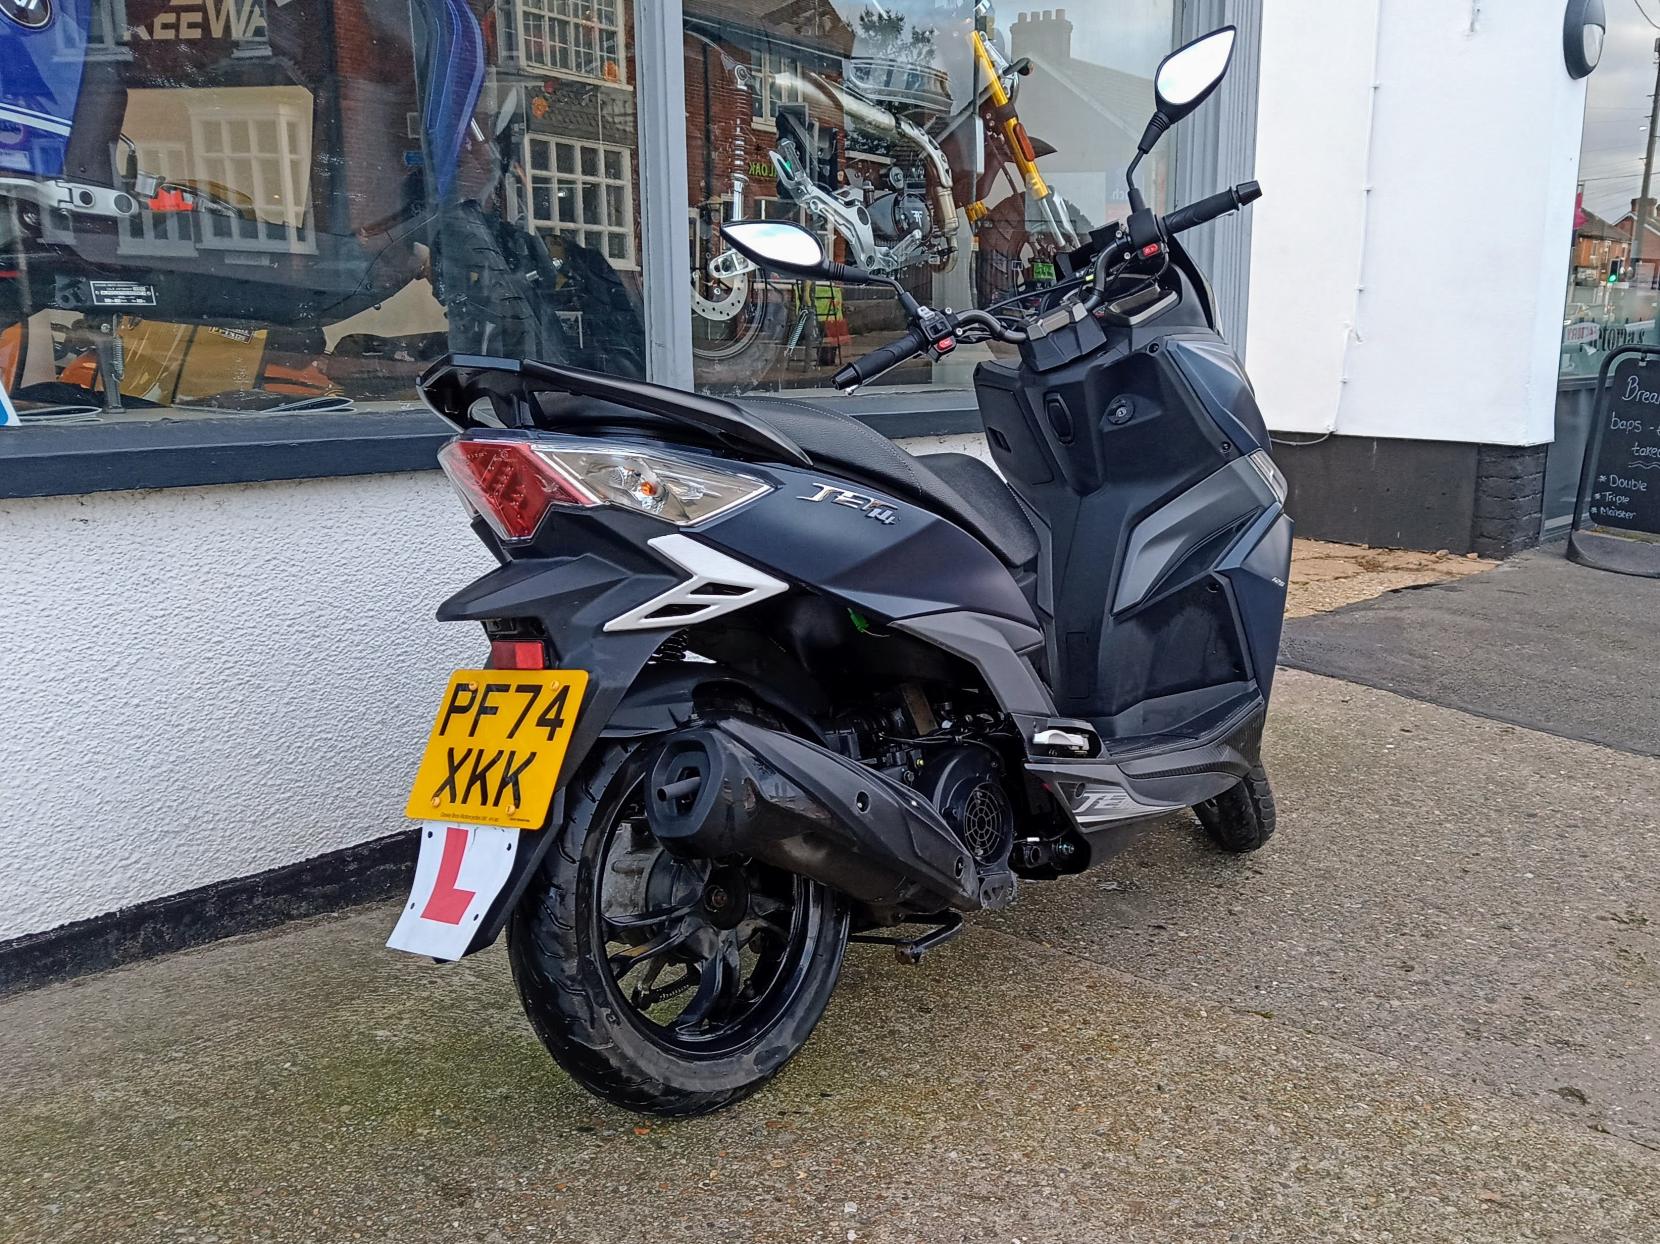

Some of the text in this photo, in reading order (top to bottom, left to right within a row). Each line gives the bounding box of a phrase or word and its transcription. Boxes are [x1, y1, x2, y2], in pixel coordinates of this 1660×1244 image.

[1611, 411, 1642, 434] baps
[1601, 491, 1630, 506] Triple
[1610, 474, 1648, 491] Double
[438, 683, 570, 741] PF74
[431, 747, 537, 809] XKK
[420, 826, 476, 925] L
